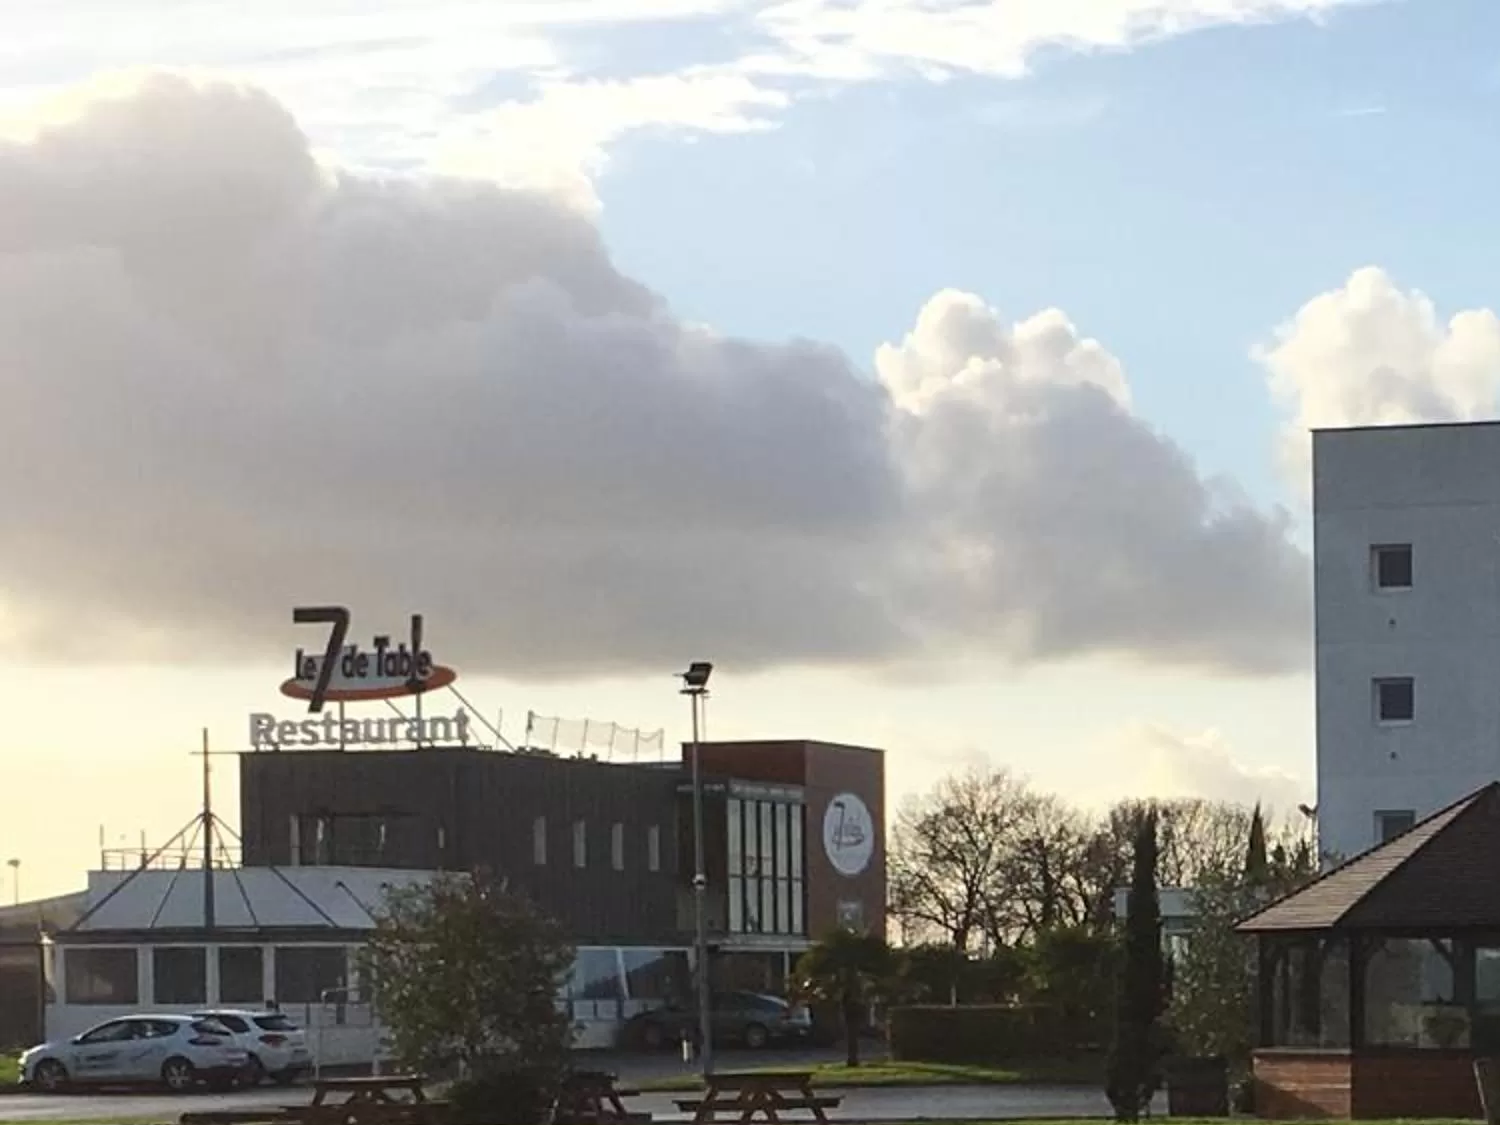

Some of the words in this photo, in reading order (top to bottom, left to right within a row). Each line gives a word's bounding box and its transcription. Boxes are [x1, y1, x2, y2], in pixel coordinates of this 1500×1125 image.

[293, 606, 350, 713] 7
[295, 648, 317, 680] Le
[341, 644, 368, 678] de
[373, 614, 433, 681] Table
[249, 707, 470, 747] Restaurant
